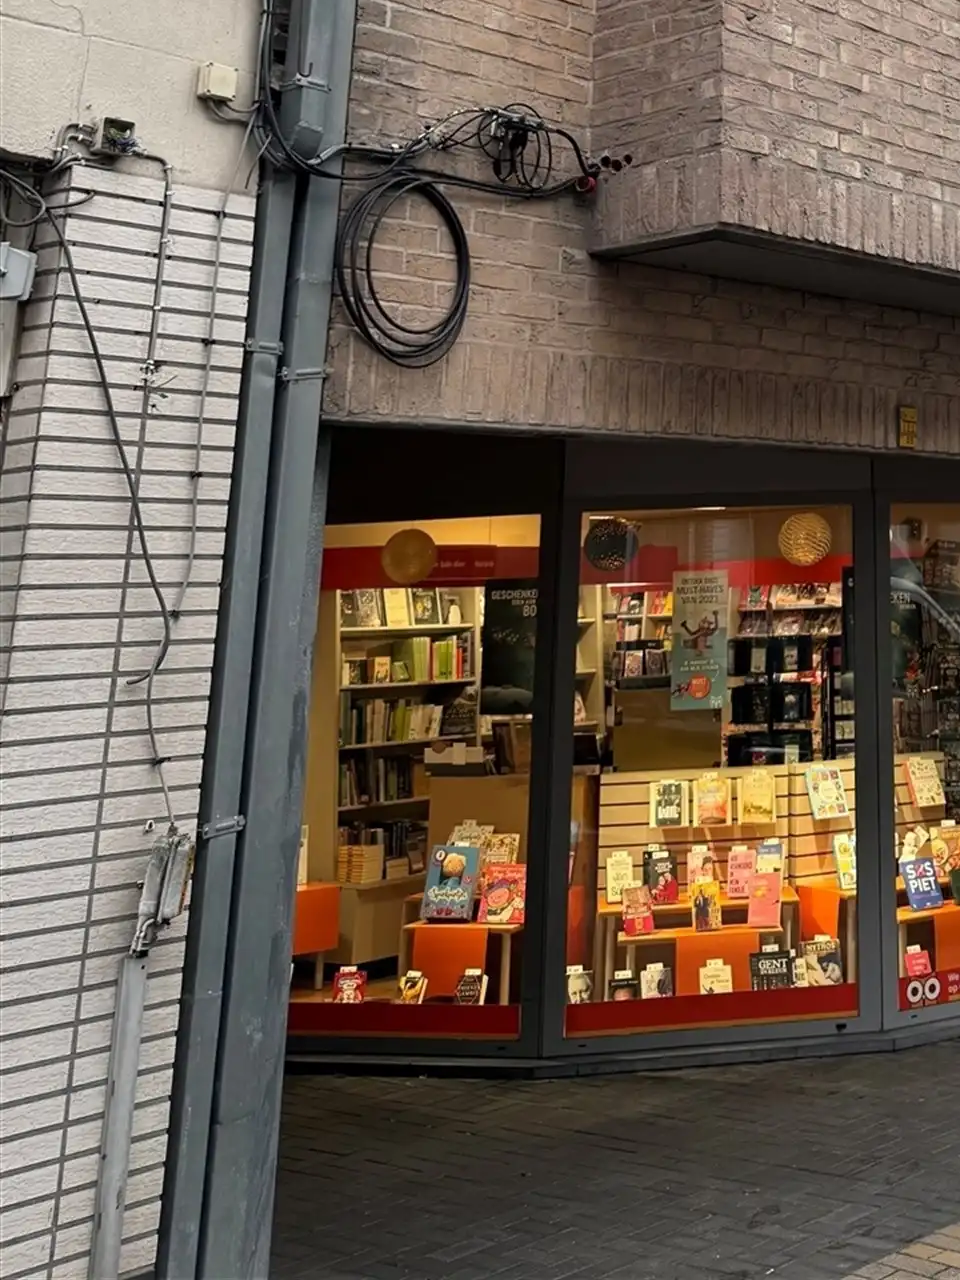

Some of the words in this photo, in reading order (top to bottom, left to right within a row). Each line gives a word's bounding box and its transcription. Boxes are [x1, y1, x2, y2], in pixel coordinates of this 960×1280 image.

[909, 877, 936, 893] PIET
[758, 958, 788, 969] GENT
[948, 974, 959, 982] We
[948, 985, 958, 993] op
